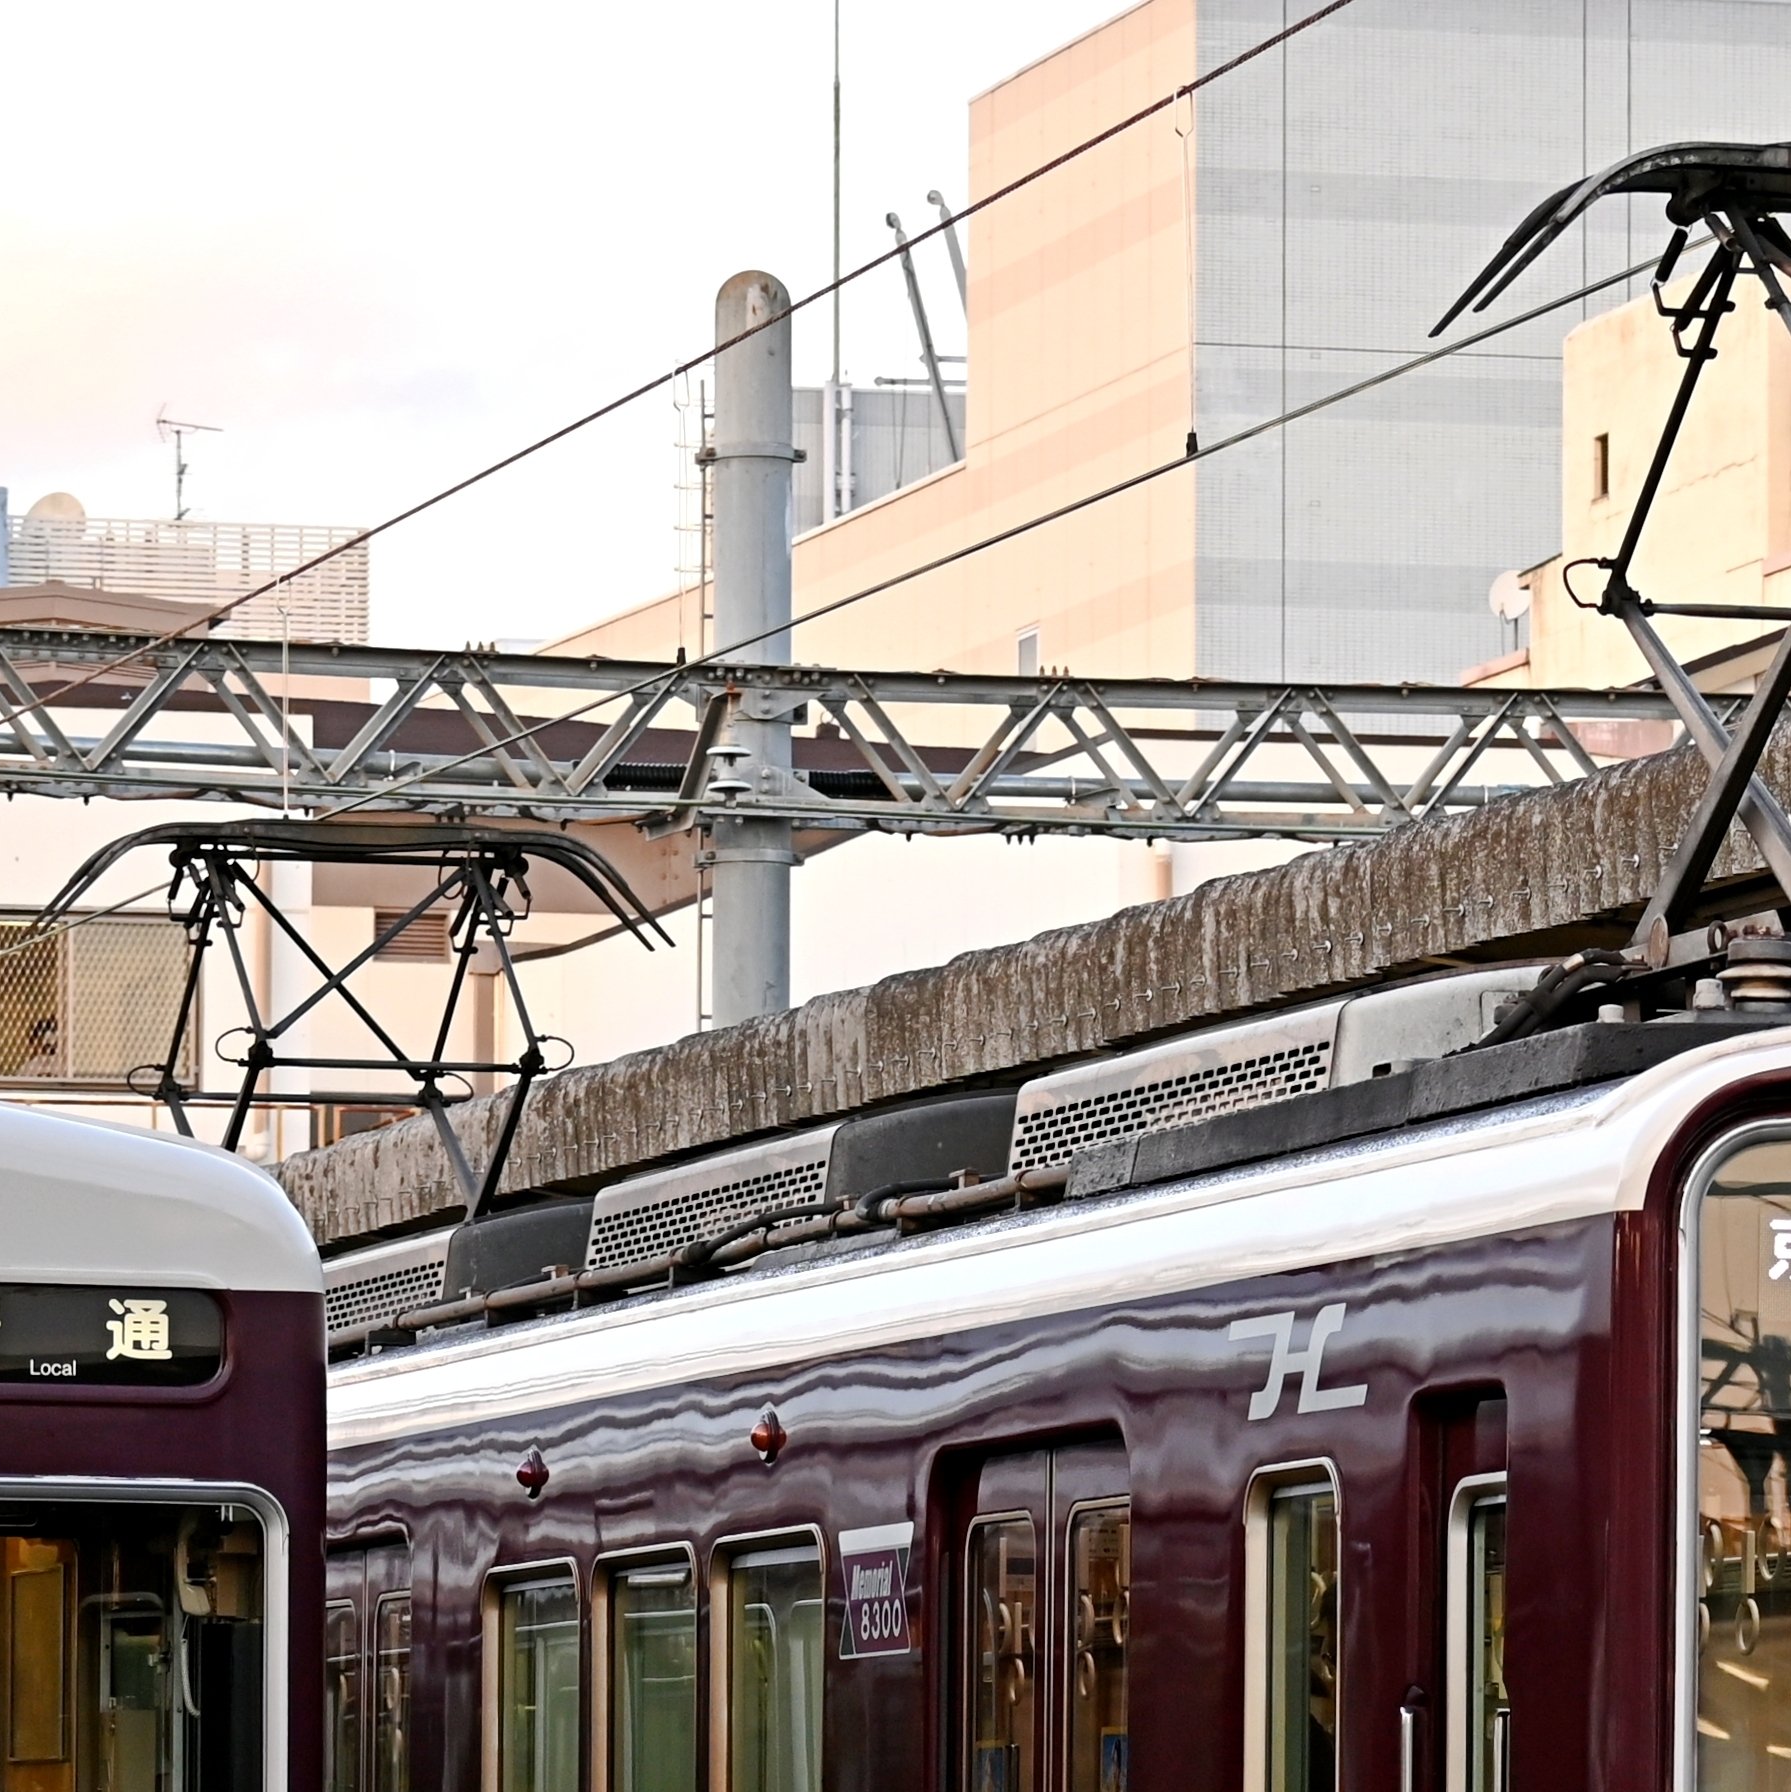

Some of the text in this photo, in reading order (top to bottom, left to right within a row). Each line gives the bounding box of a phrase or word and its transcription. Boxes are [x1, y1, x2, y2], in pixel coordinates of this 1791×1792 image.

[29, 1359, 77, 1377] Local
[851, 1560, 893, 1600] Memorial
[860, 1599, 902, 1641] 8300
